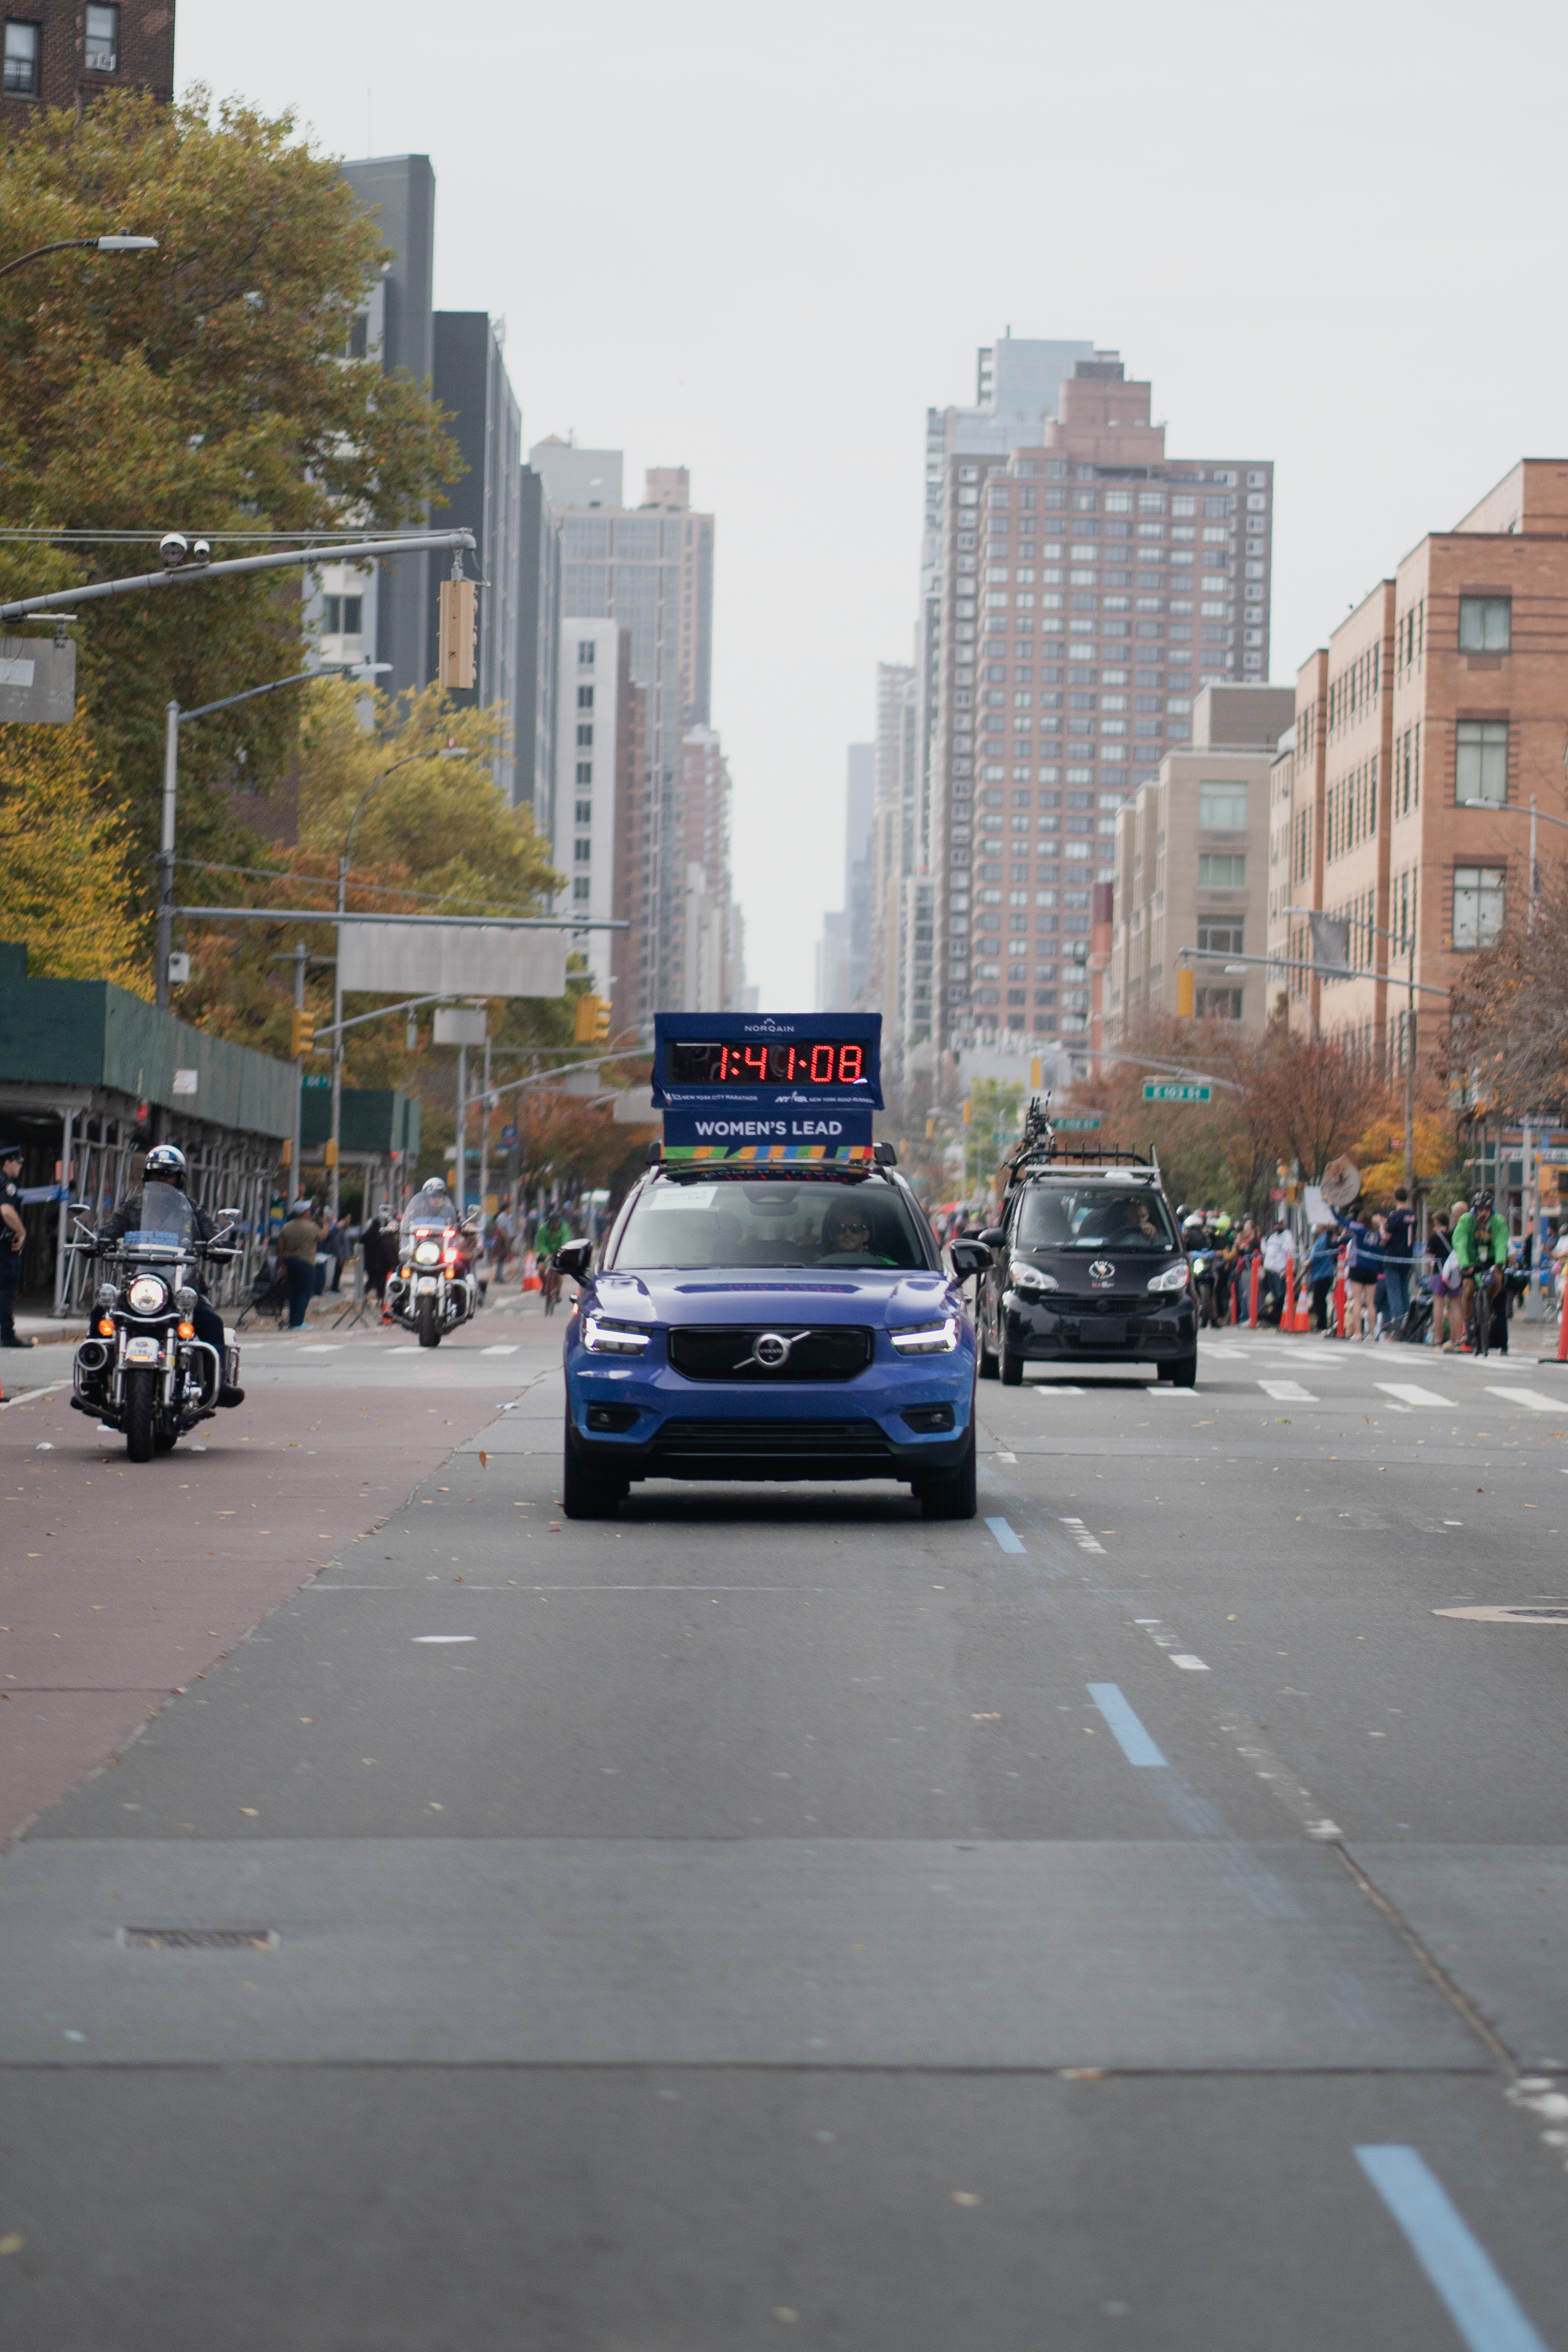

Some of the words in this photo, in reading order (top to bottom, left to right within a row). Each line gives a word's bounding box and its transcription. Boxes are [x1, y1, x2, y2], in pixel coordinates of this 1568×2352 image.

[1164, 1087, 1183, 1098] 103
[694, 1120, 787, 1136] WOMEN'S
[792, 1120, 843, 1136] LEAD
